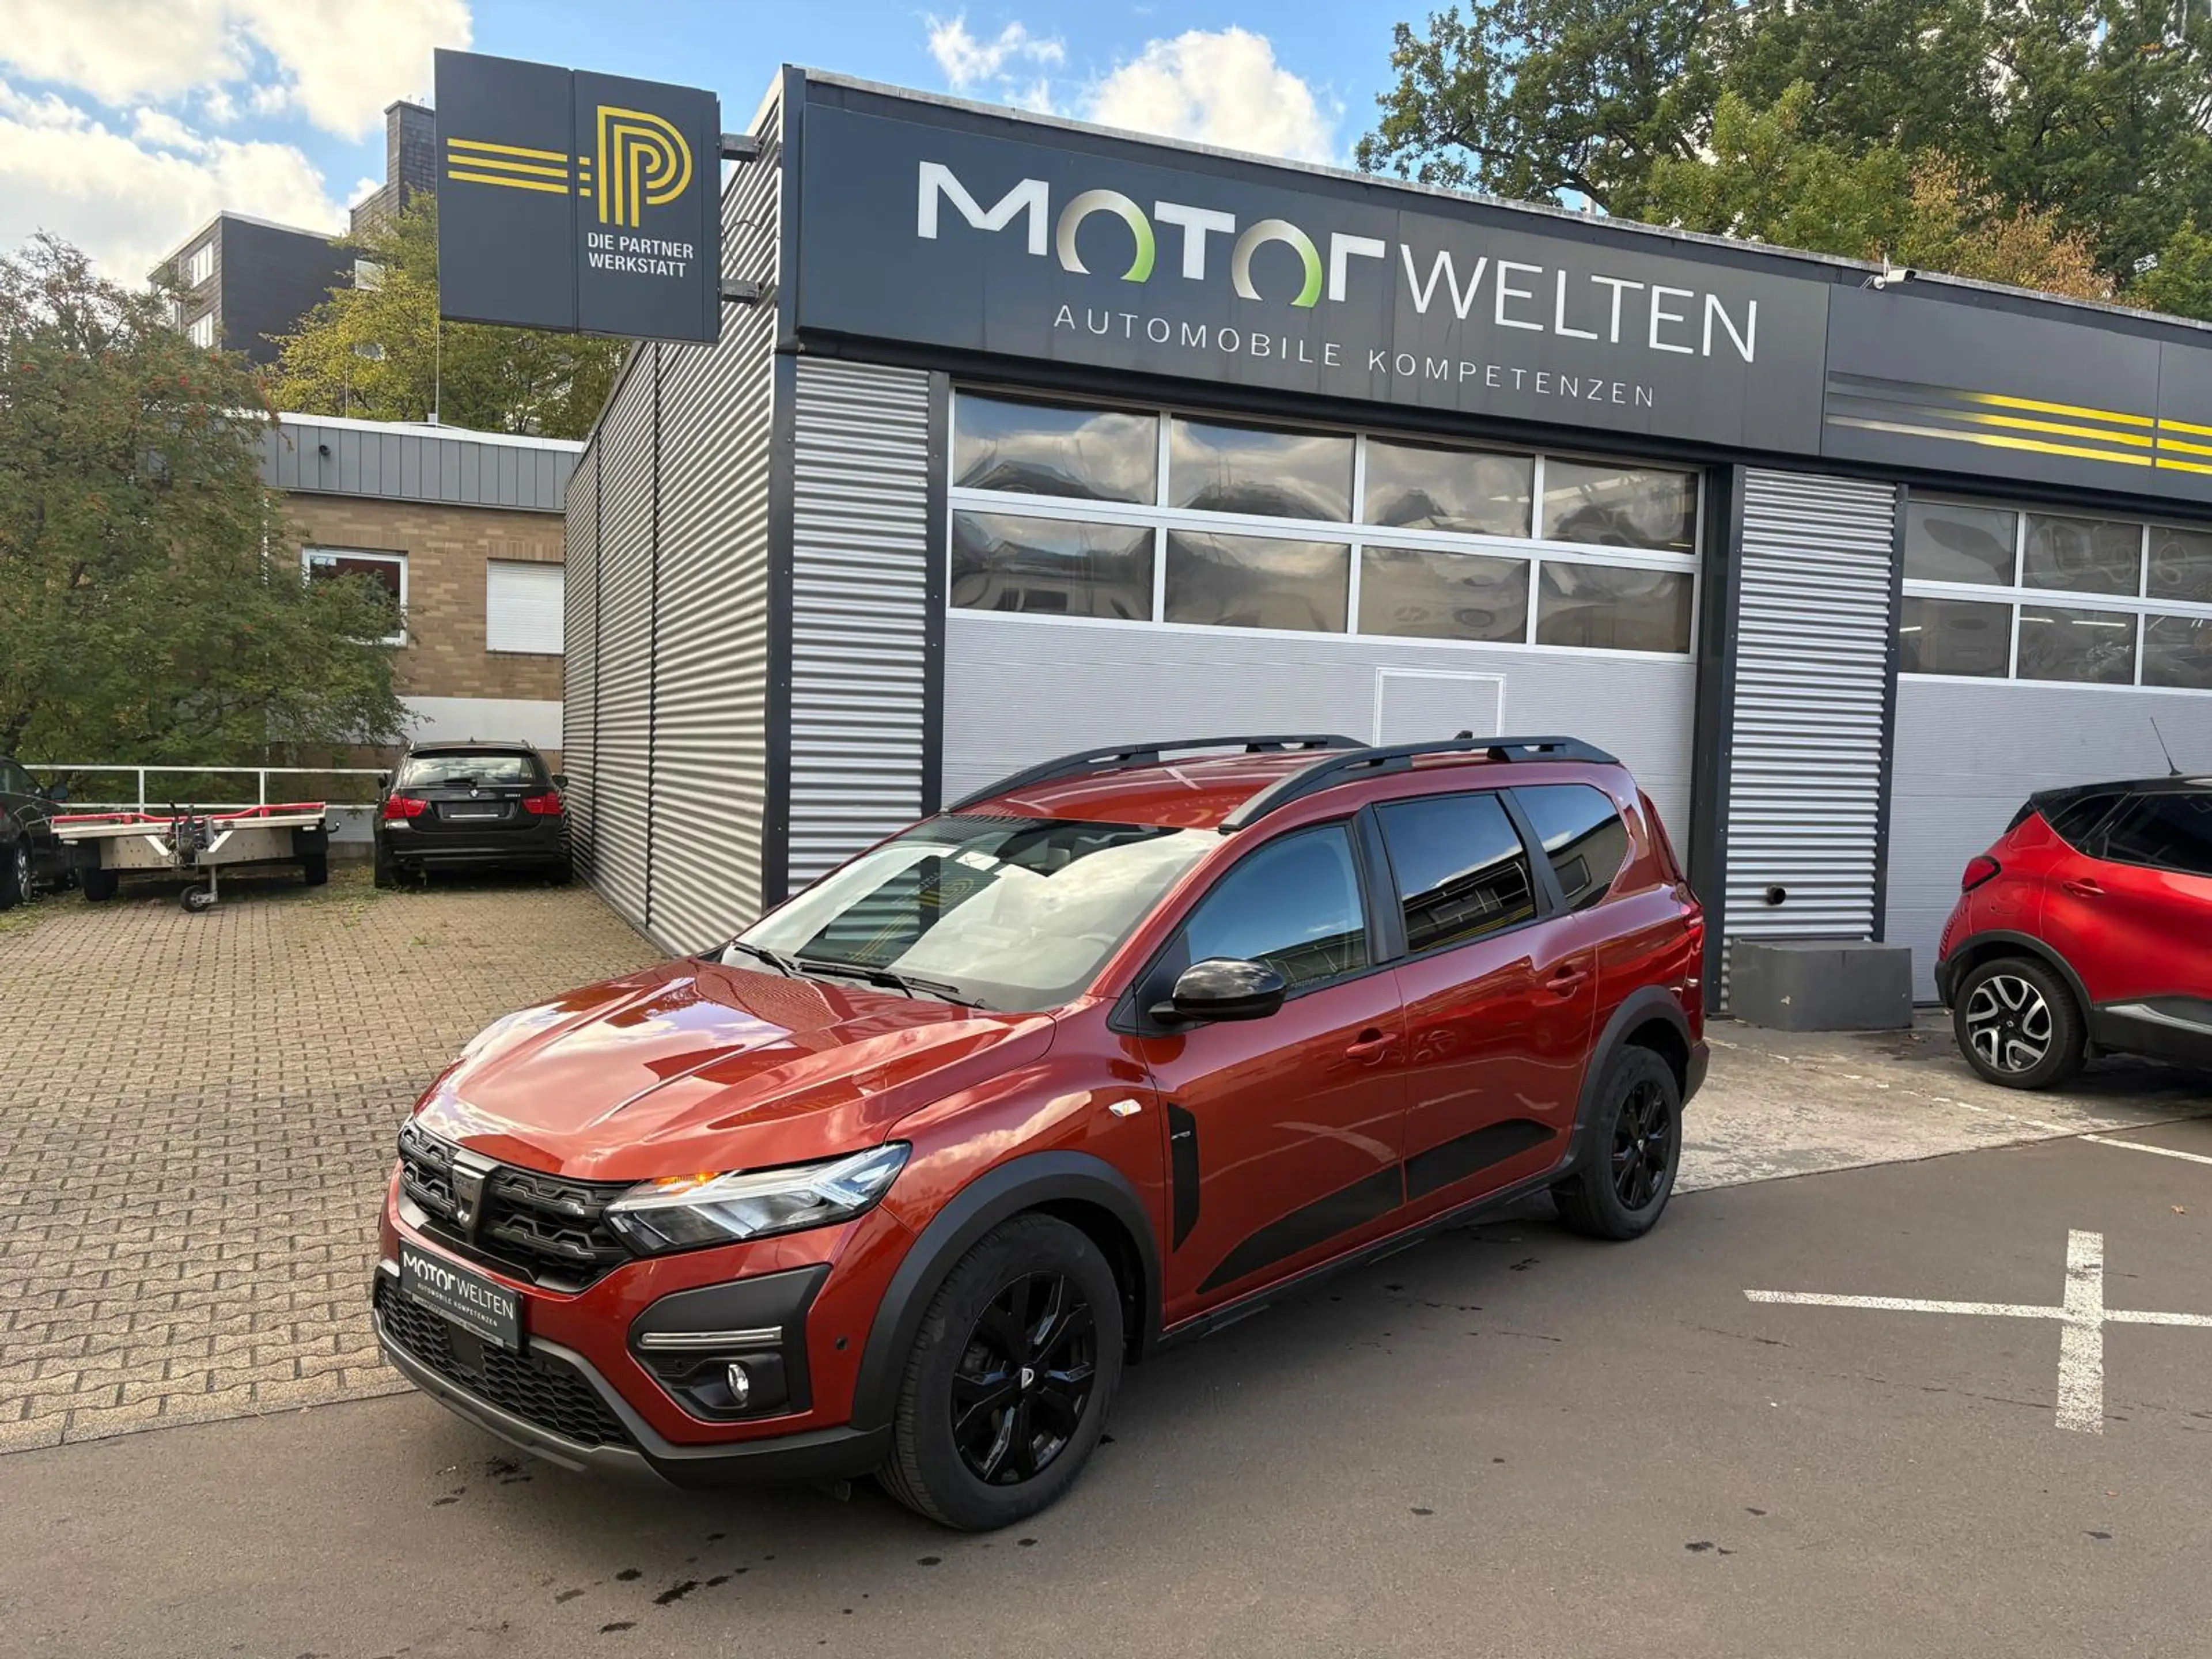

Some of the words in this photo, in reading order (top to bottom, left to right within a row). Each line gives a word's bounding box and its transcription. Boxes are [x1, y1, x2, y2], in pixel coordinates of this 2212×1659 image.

[587, 232, 615, 251] DIE
[619, 236, 694, 259] PARTNER
[588, 252, 686, 278] WERKSTATT
[1054, 304, 1342, 367] AUTOMOBILE
[1368, 349, 1654, 408] KOMPETENZEN
